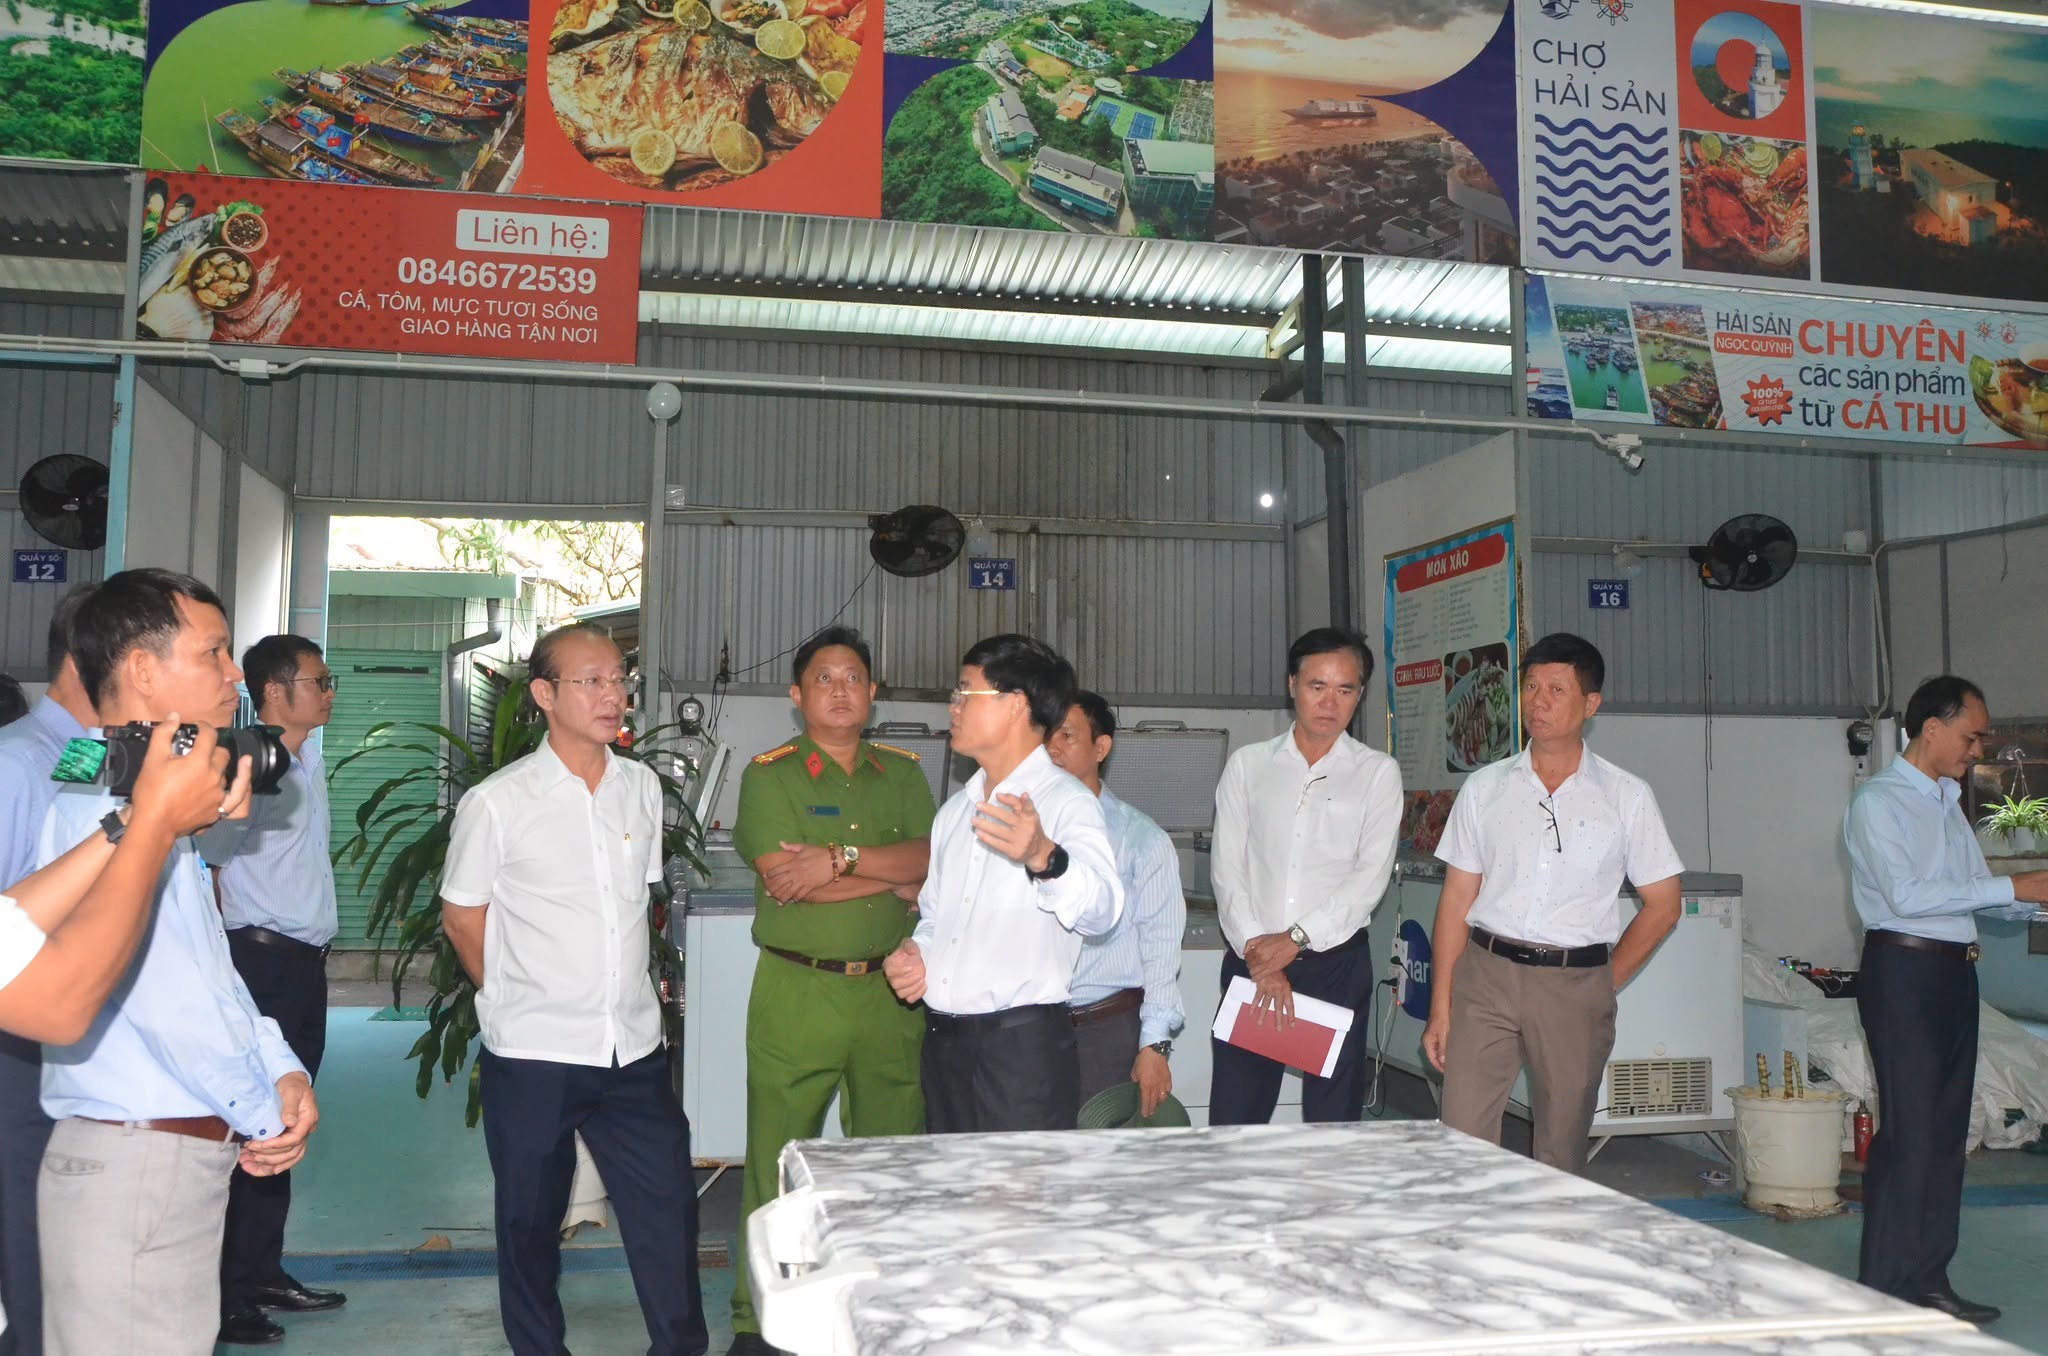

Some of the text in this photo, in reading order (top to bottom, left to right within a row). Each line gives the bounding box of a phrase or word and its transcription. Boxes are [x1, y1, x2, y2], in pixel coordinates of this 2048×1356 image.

[1532, 38, 1606, 76] CHỢ
[1535, 73, 1666, 117] HẢI SẢN
[473, 216, 598, 254] Liên hệ:
[397, 256, 597, 295] 0846672539
[338, 289, 599, 321] CÁ, TÔM, MỰC TƯƠI SỐNG
[400, 317, 598, 344] GIAO HÀNG TẬN NƠI
[1716, 308, 1792, 336] HẢI SẢN
[1716, 336, 1750, 351] NGỌC
[1798, 318, 1966, 365] CHUYÊN
[1752, 387, 1784, 399] 100%
[1847, 363, 1890, 391] sản
[1895, 365, 1966, 396] phẩm
[1798, 392, 1966, 435] từ CÁ THU
[28, 563, 56, 580] 12
[981, 571, 1004, 586] 14
[1599, 592, 1621, 606] 16
